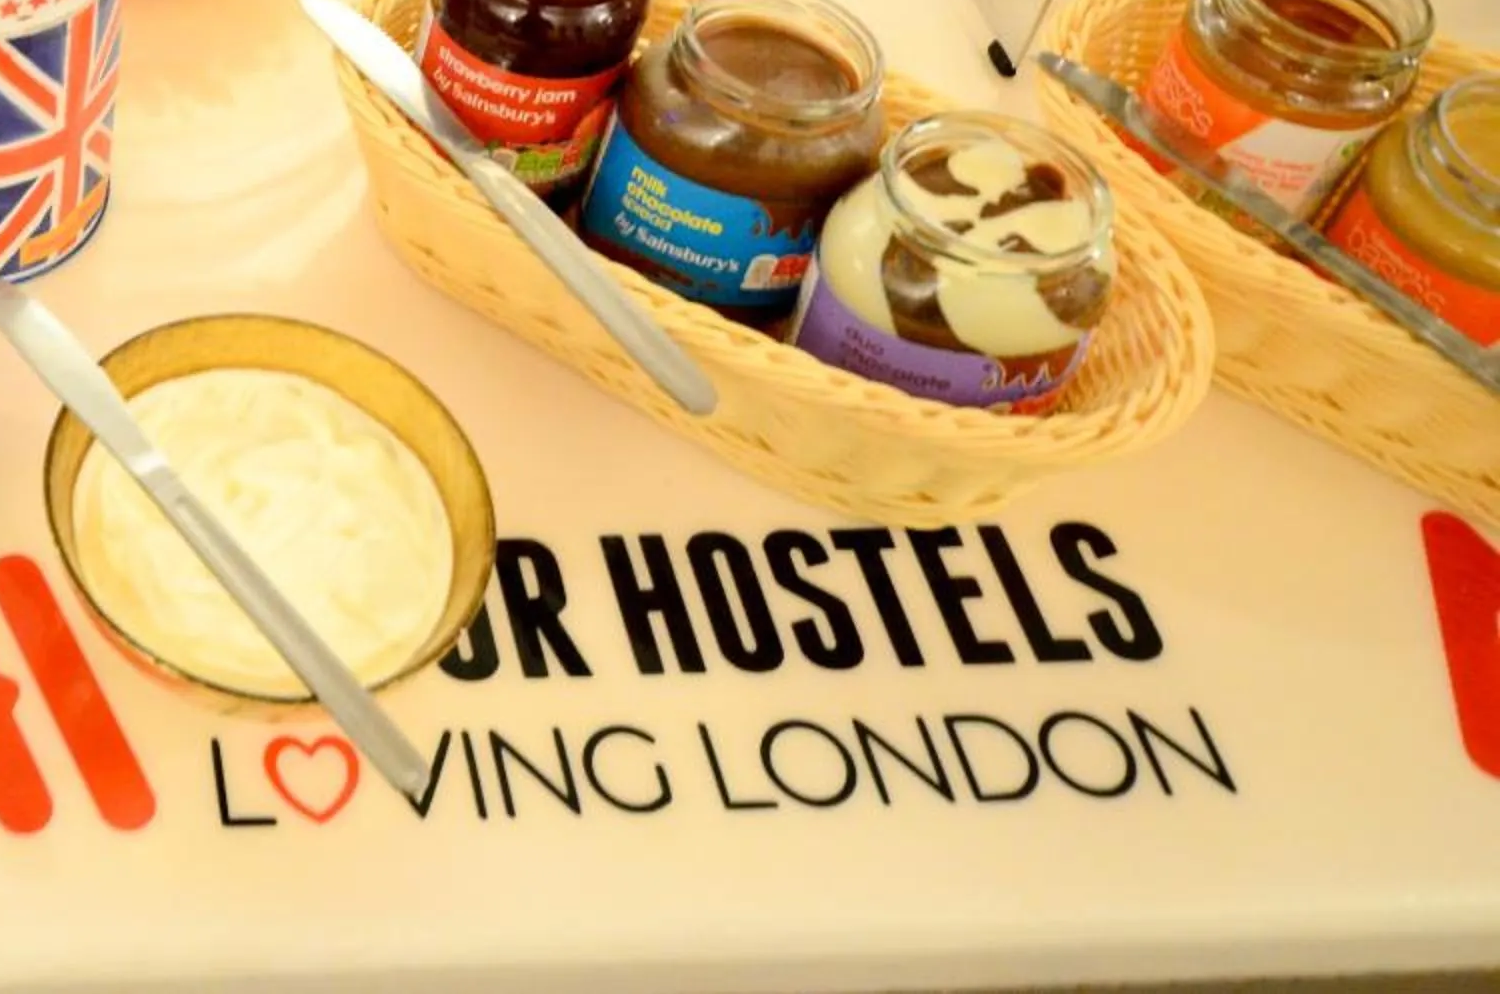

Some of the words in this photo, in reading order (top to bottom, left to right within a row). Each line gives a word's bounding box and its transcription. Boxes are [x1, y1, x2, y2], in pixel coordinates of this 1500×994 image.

[433, 66, 452, 93] by
[451, 82, 557, 126] Sainsbury's
[439, 46, 533, 103] strawberry
[534, 86, 578, 105] jam
[626, 181, 724, 236] chocolate
[631, 165, 668, 198] milk
[614, 211, 637, 236] by
[635, 226, 741, 274] Sainsbury's
[845, 326, 885, 356] duo
[597, 520, 1165, 676] HOSTELS
[698, 707, 1238, 811] LONDON
